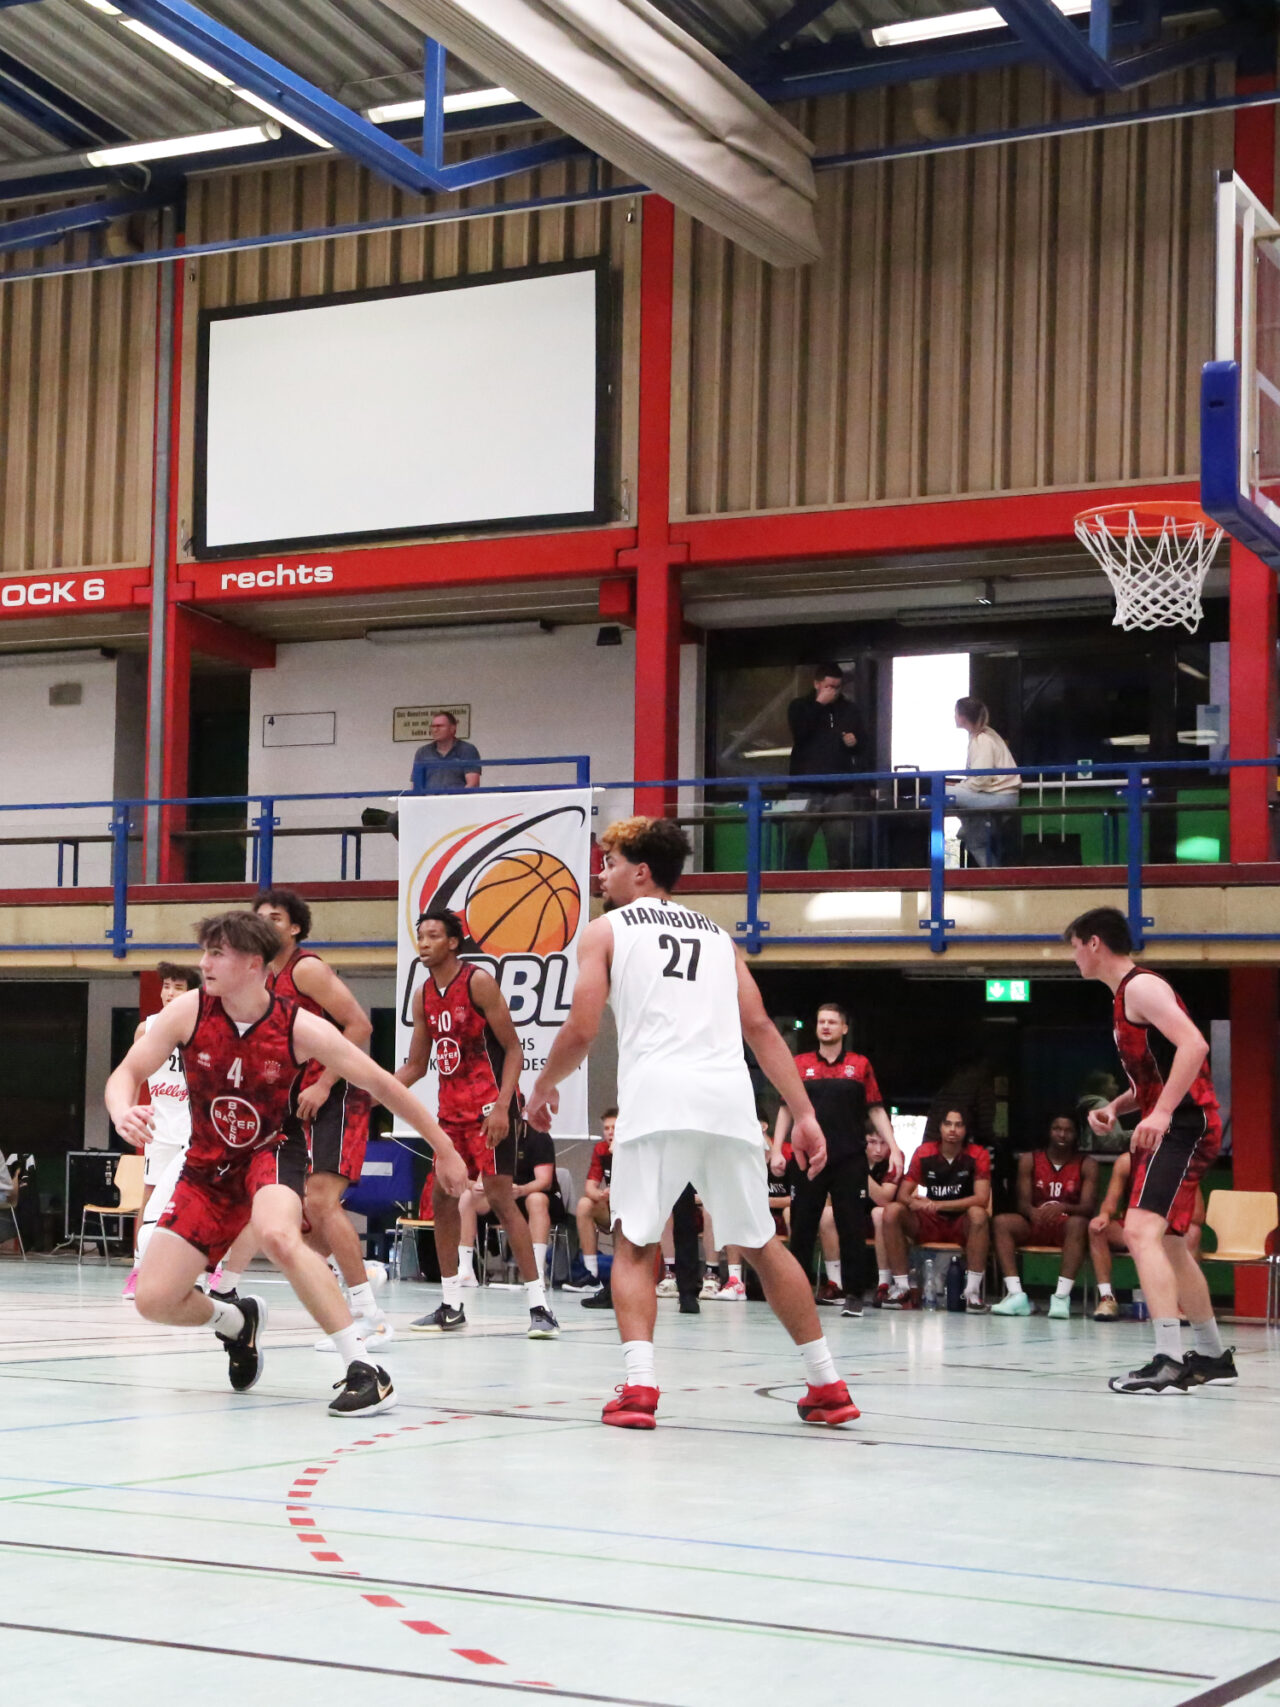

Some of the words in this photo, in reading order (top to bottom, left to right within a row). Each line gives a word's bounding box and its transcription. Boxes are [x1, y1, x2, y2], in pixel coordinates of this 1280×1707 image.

[221, 563, 334, 590] rechts
[83, 578, 105, 601] 6
[659, 934, 701, 981] 27
[438, 1010, 452, 1033] 10
[227, 1057, 243, 1089] 4
[150, 1082, 190, 1102] Kellog
[215, 1110, 256, 1130] BAYER
[228, 1101, 237, 1143] BAYER
[1049, 1181, 1063, 1198] 18
